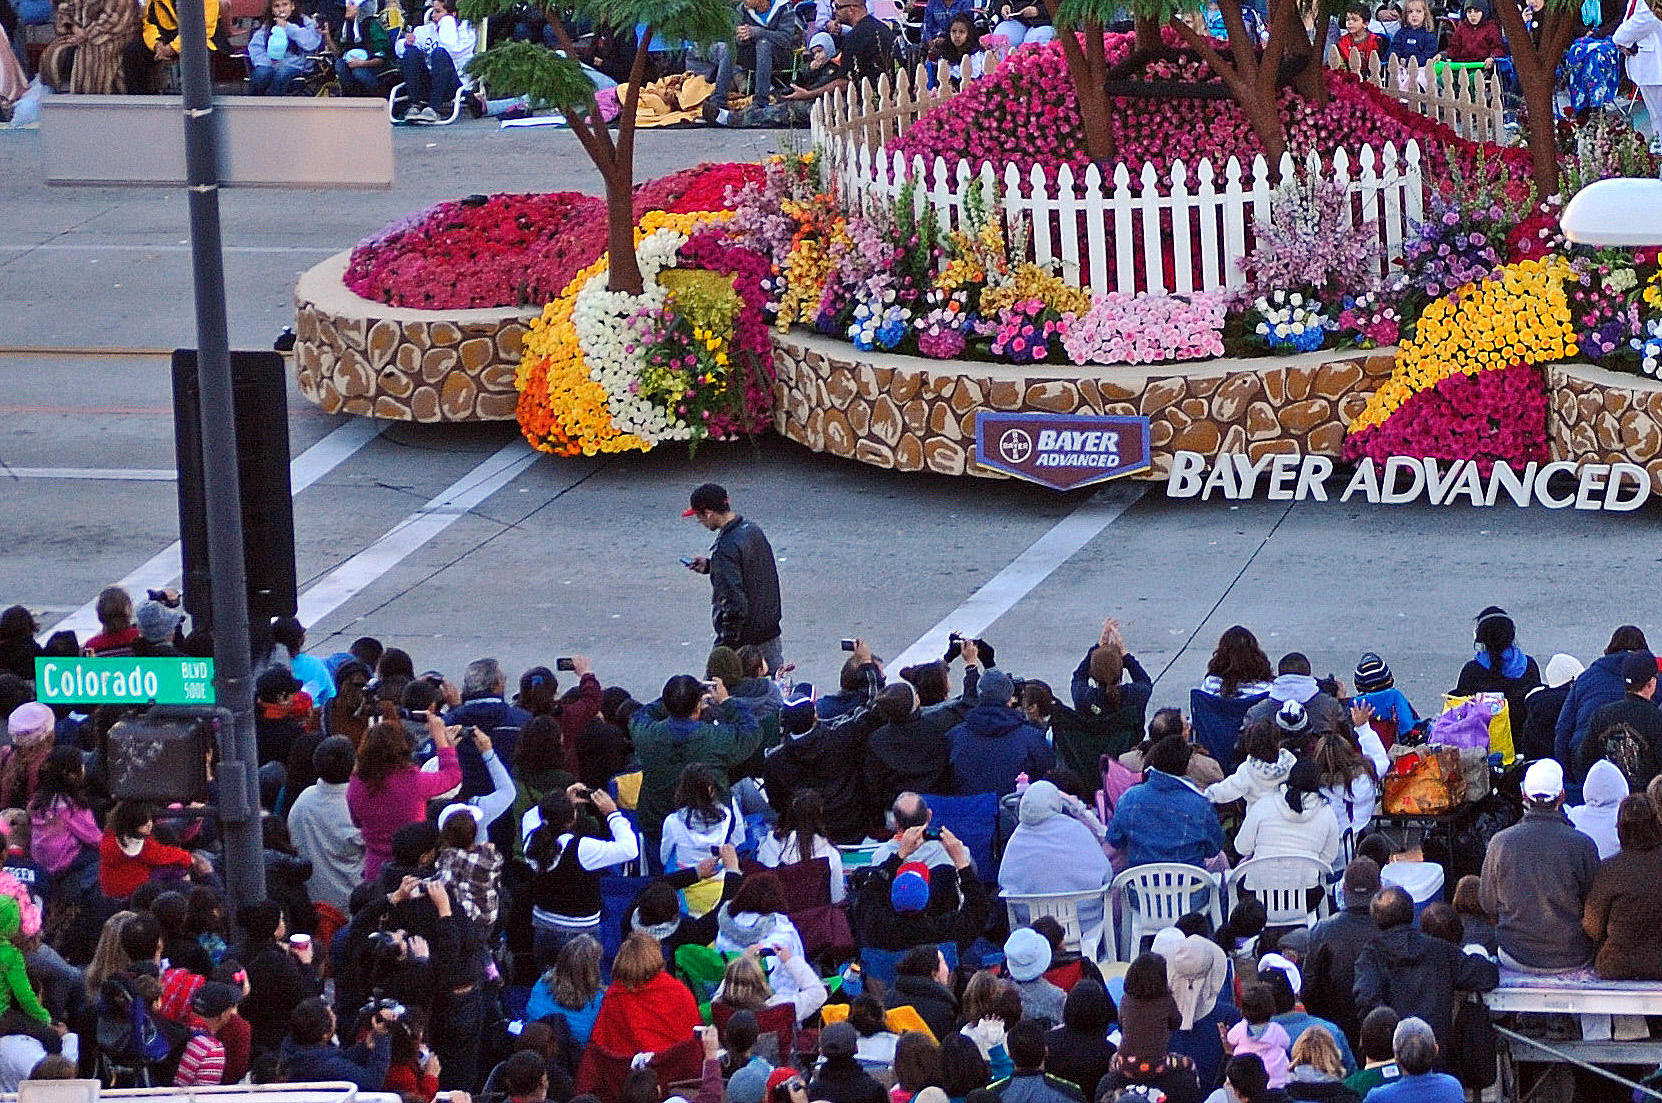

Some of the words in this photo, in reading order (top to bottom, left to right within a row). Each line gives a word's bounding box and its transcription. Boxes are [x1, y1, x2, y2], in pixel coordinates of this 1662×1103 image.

[1037, 430, 1120, 452] BAYER
[1035, 454, 1120, 468] ADVANCED
[1166, 450, 1333, 501] BAYER
[1340, 455, 1651, 512] ADVANCED
[43, 663, 158, 697] Colorado
[181, 661, 208, 679] BLVD
